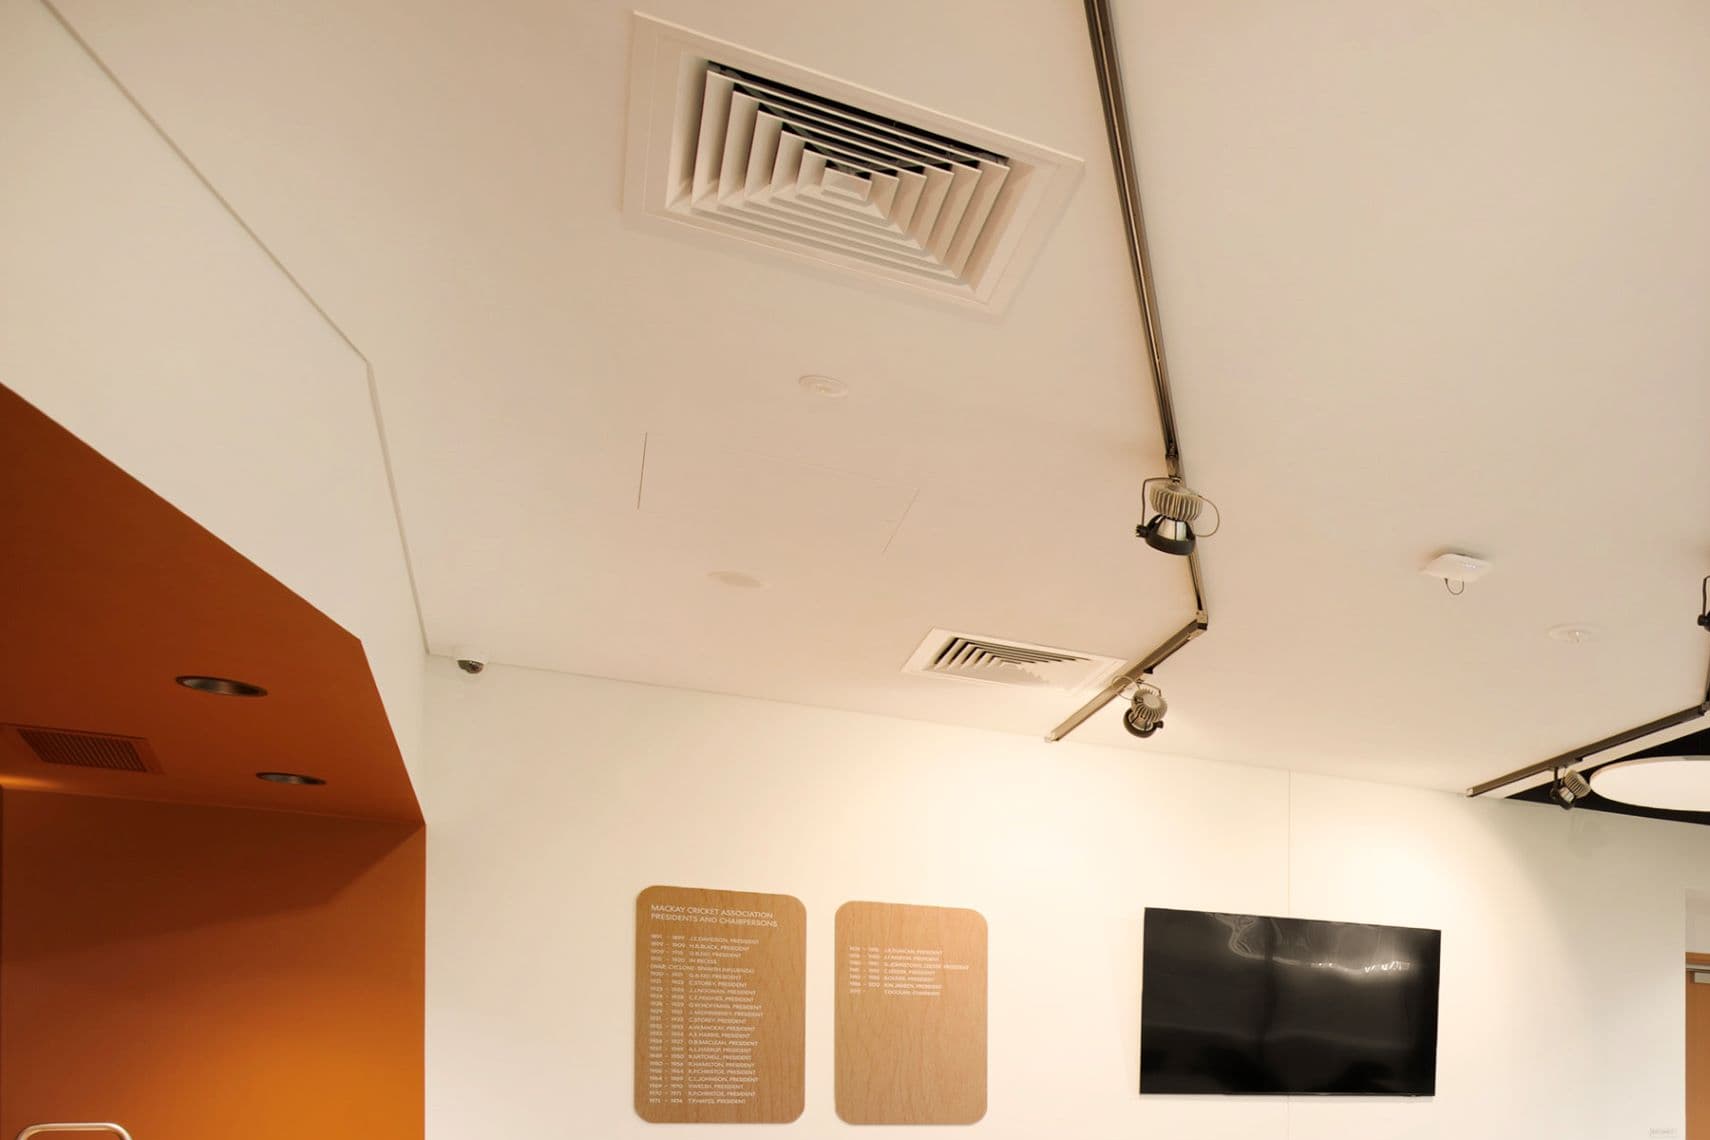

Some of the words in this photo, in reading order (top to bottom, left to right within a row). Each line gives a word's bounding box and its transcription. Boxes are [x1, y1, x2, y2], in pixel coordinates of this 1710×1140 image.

[651, 904, 686, 914] MACKAY
[687, 906, 719, 915] CRICKET
[720, 909, 773, 919] ASSOCIATION
[651, 913, 698, 922] PRESIDENTS
[699, 916, 717, 924] AND
[719, 917, 778, 928] CHAIRPERSONS
